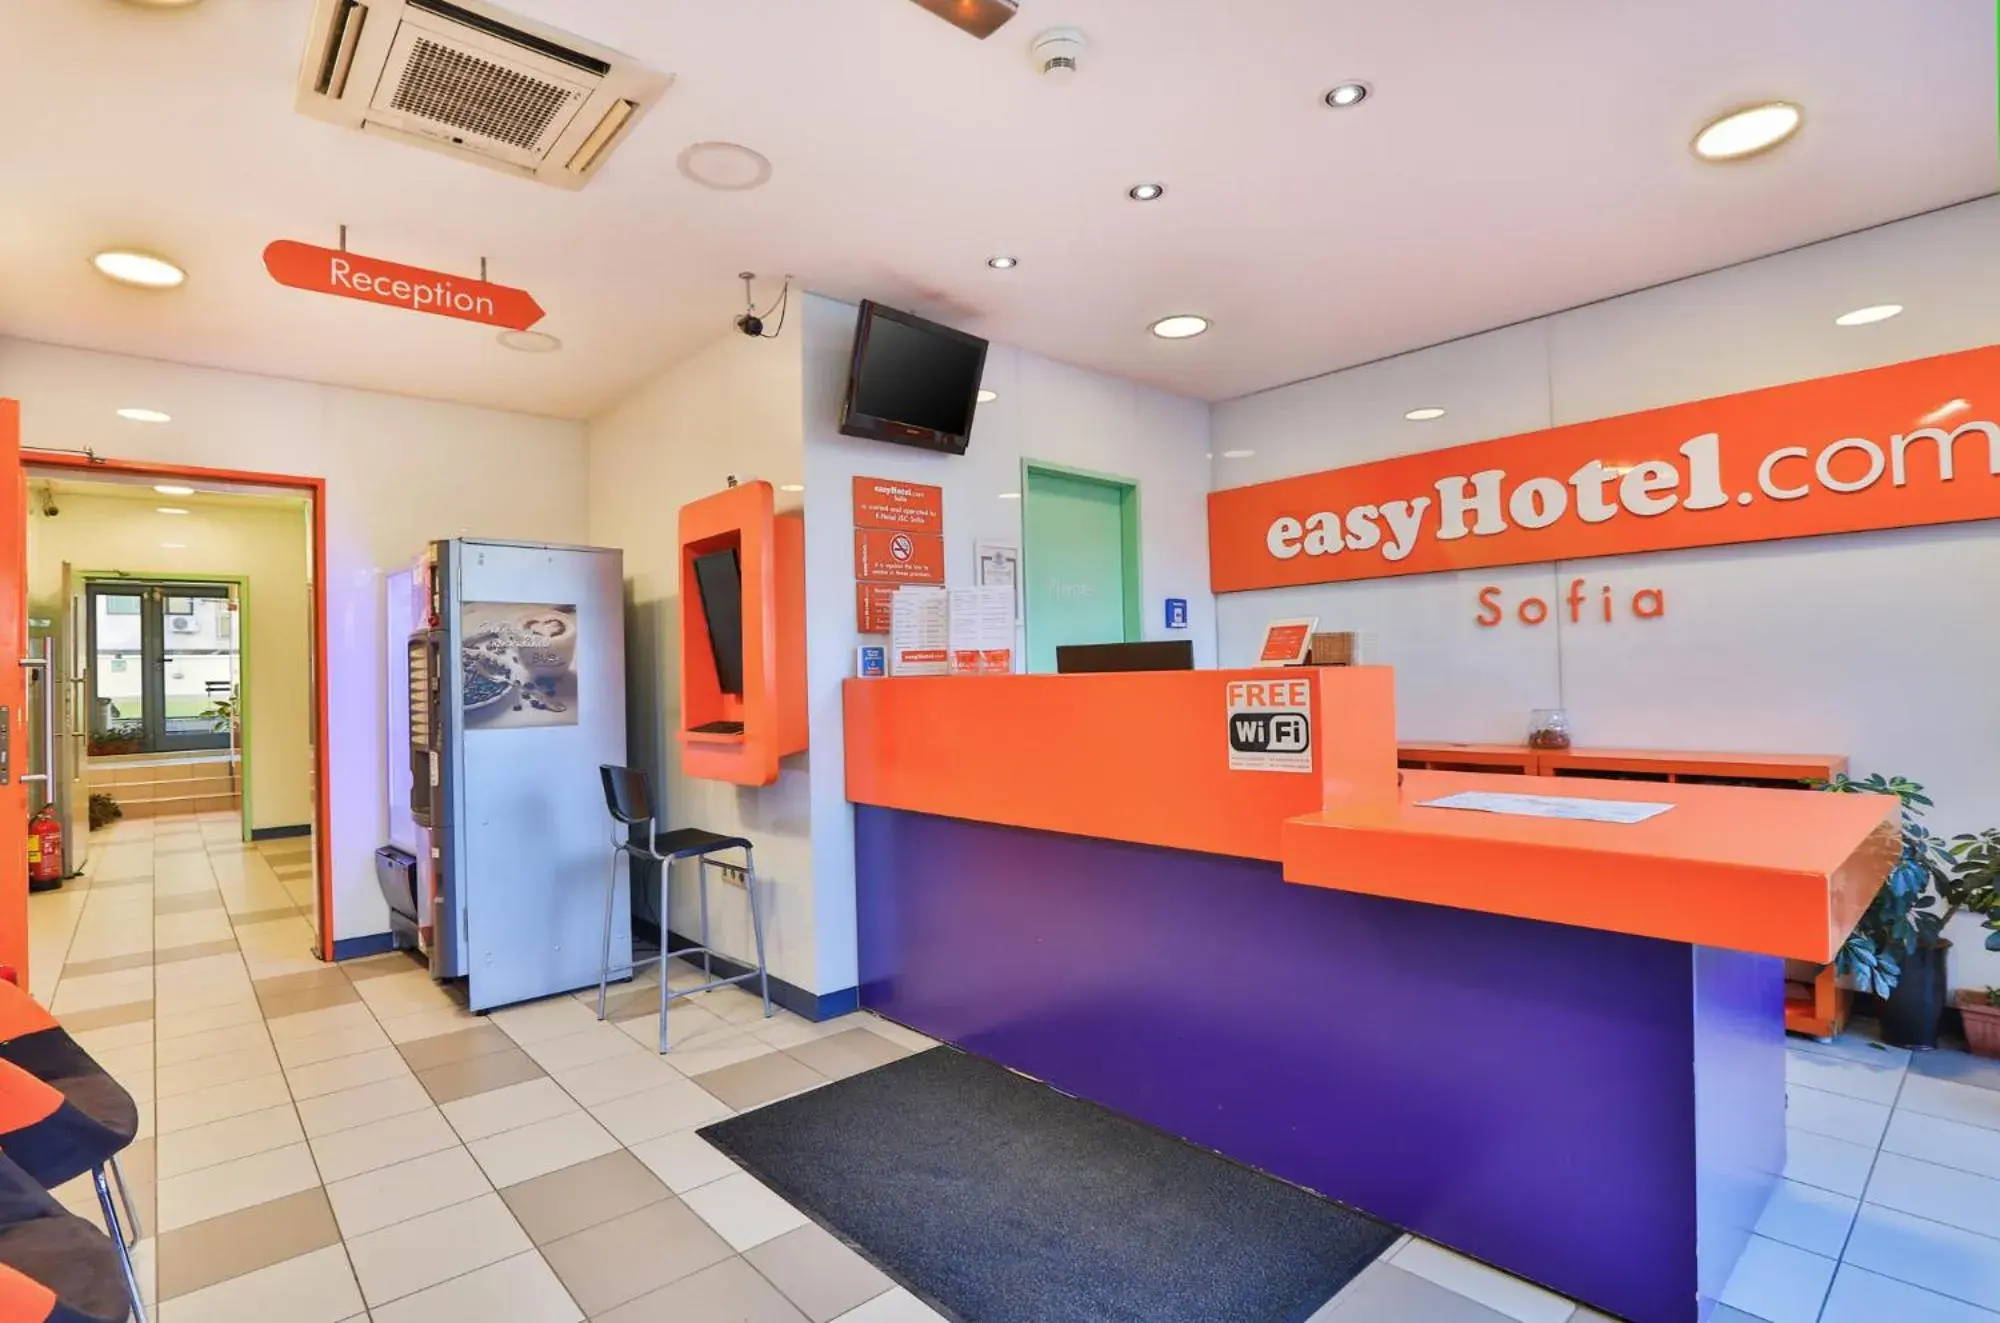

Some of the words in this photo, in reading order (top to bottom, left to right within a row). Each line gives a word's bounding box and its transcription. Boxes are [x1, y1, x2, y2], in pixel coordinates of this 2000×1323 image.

[330, 257, 494, 315] Reception
[1266, 420, 2000, 562] easyHotel.com
[1475, 578, 1664, 628] Sofia
[1229, 682, 1306, 707] FREE
